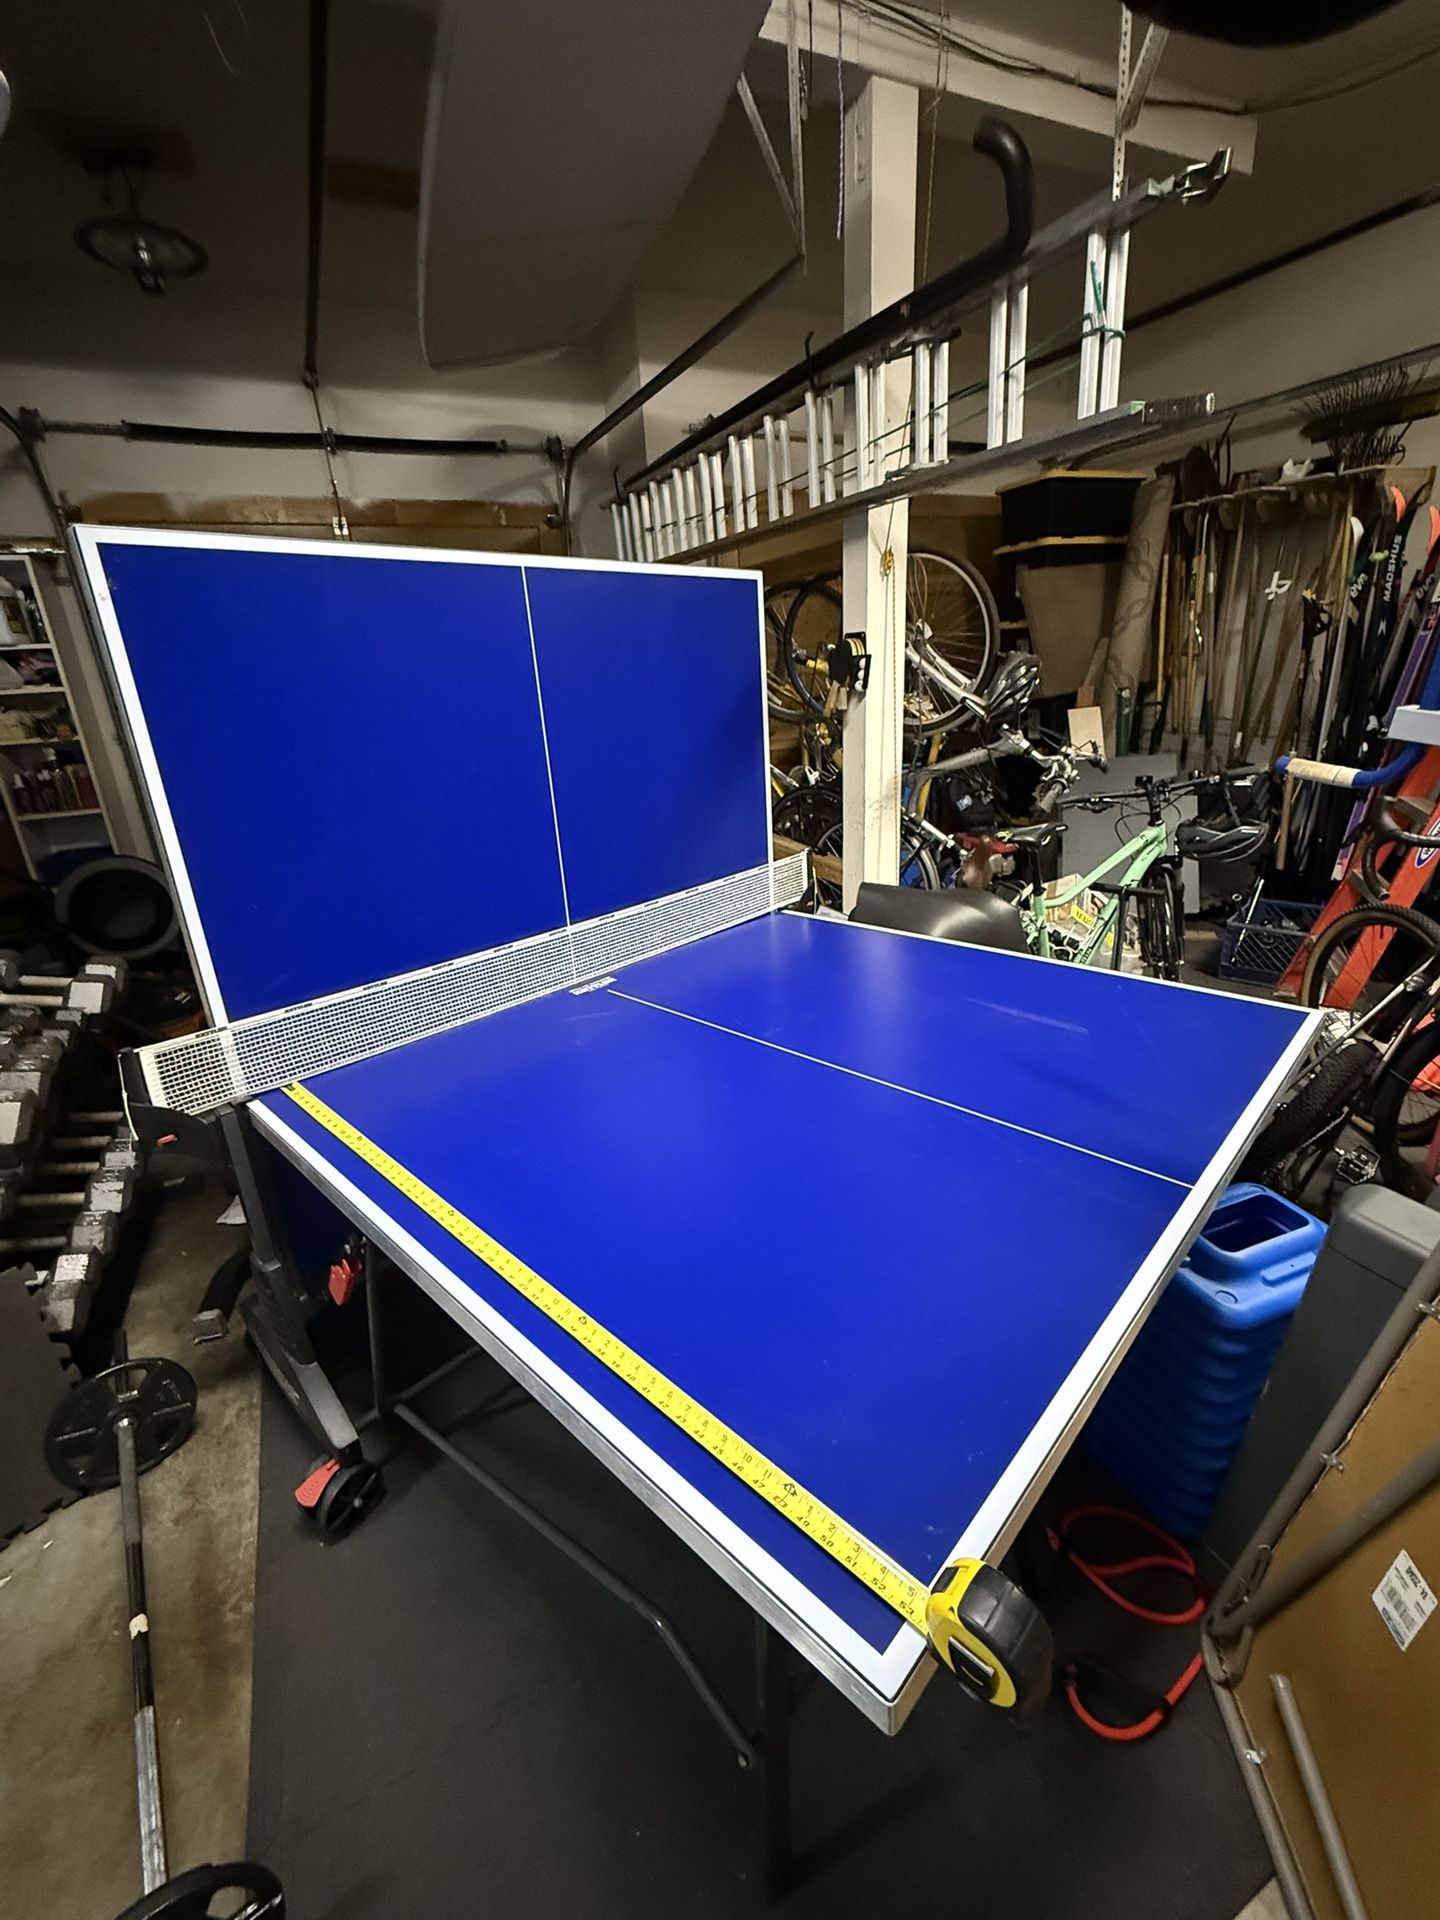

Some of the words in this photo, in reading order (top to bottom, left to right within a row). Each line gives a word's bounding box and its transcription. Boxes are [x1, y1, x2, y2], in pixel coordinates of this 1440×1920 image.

[1383, 535, 1402, 602] MADSHUS
[712, 1445, 724, 1455] 45
[732, 1462, 744, 1472] 46
[753, 1479, 765, 1488] 47
[820, 1534, 834, 1548] 50
[844, 1555, 857, 1567] 51
[871, 1577, 886, 1591] 52
[899, 1601, 914, 1616] 53
[743, 1452, 752, 1463] 10
[764, 1469, 772, 1479] 11
[828, 1523, 836, 1533] 2
[907, 1586, 915, 1597] 5
